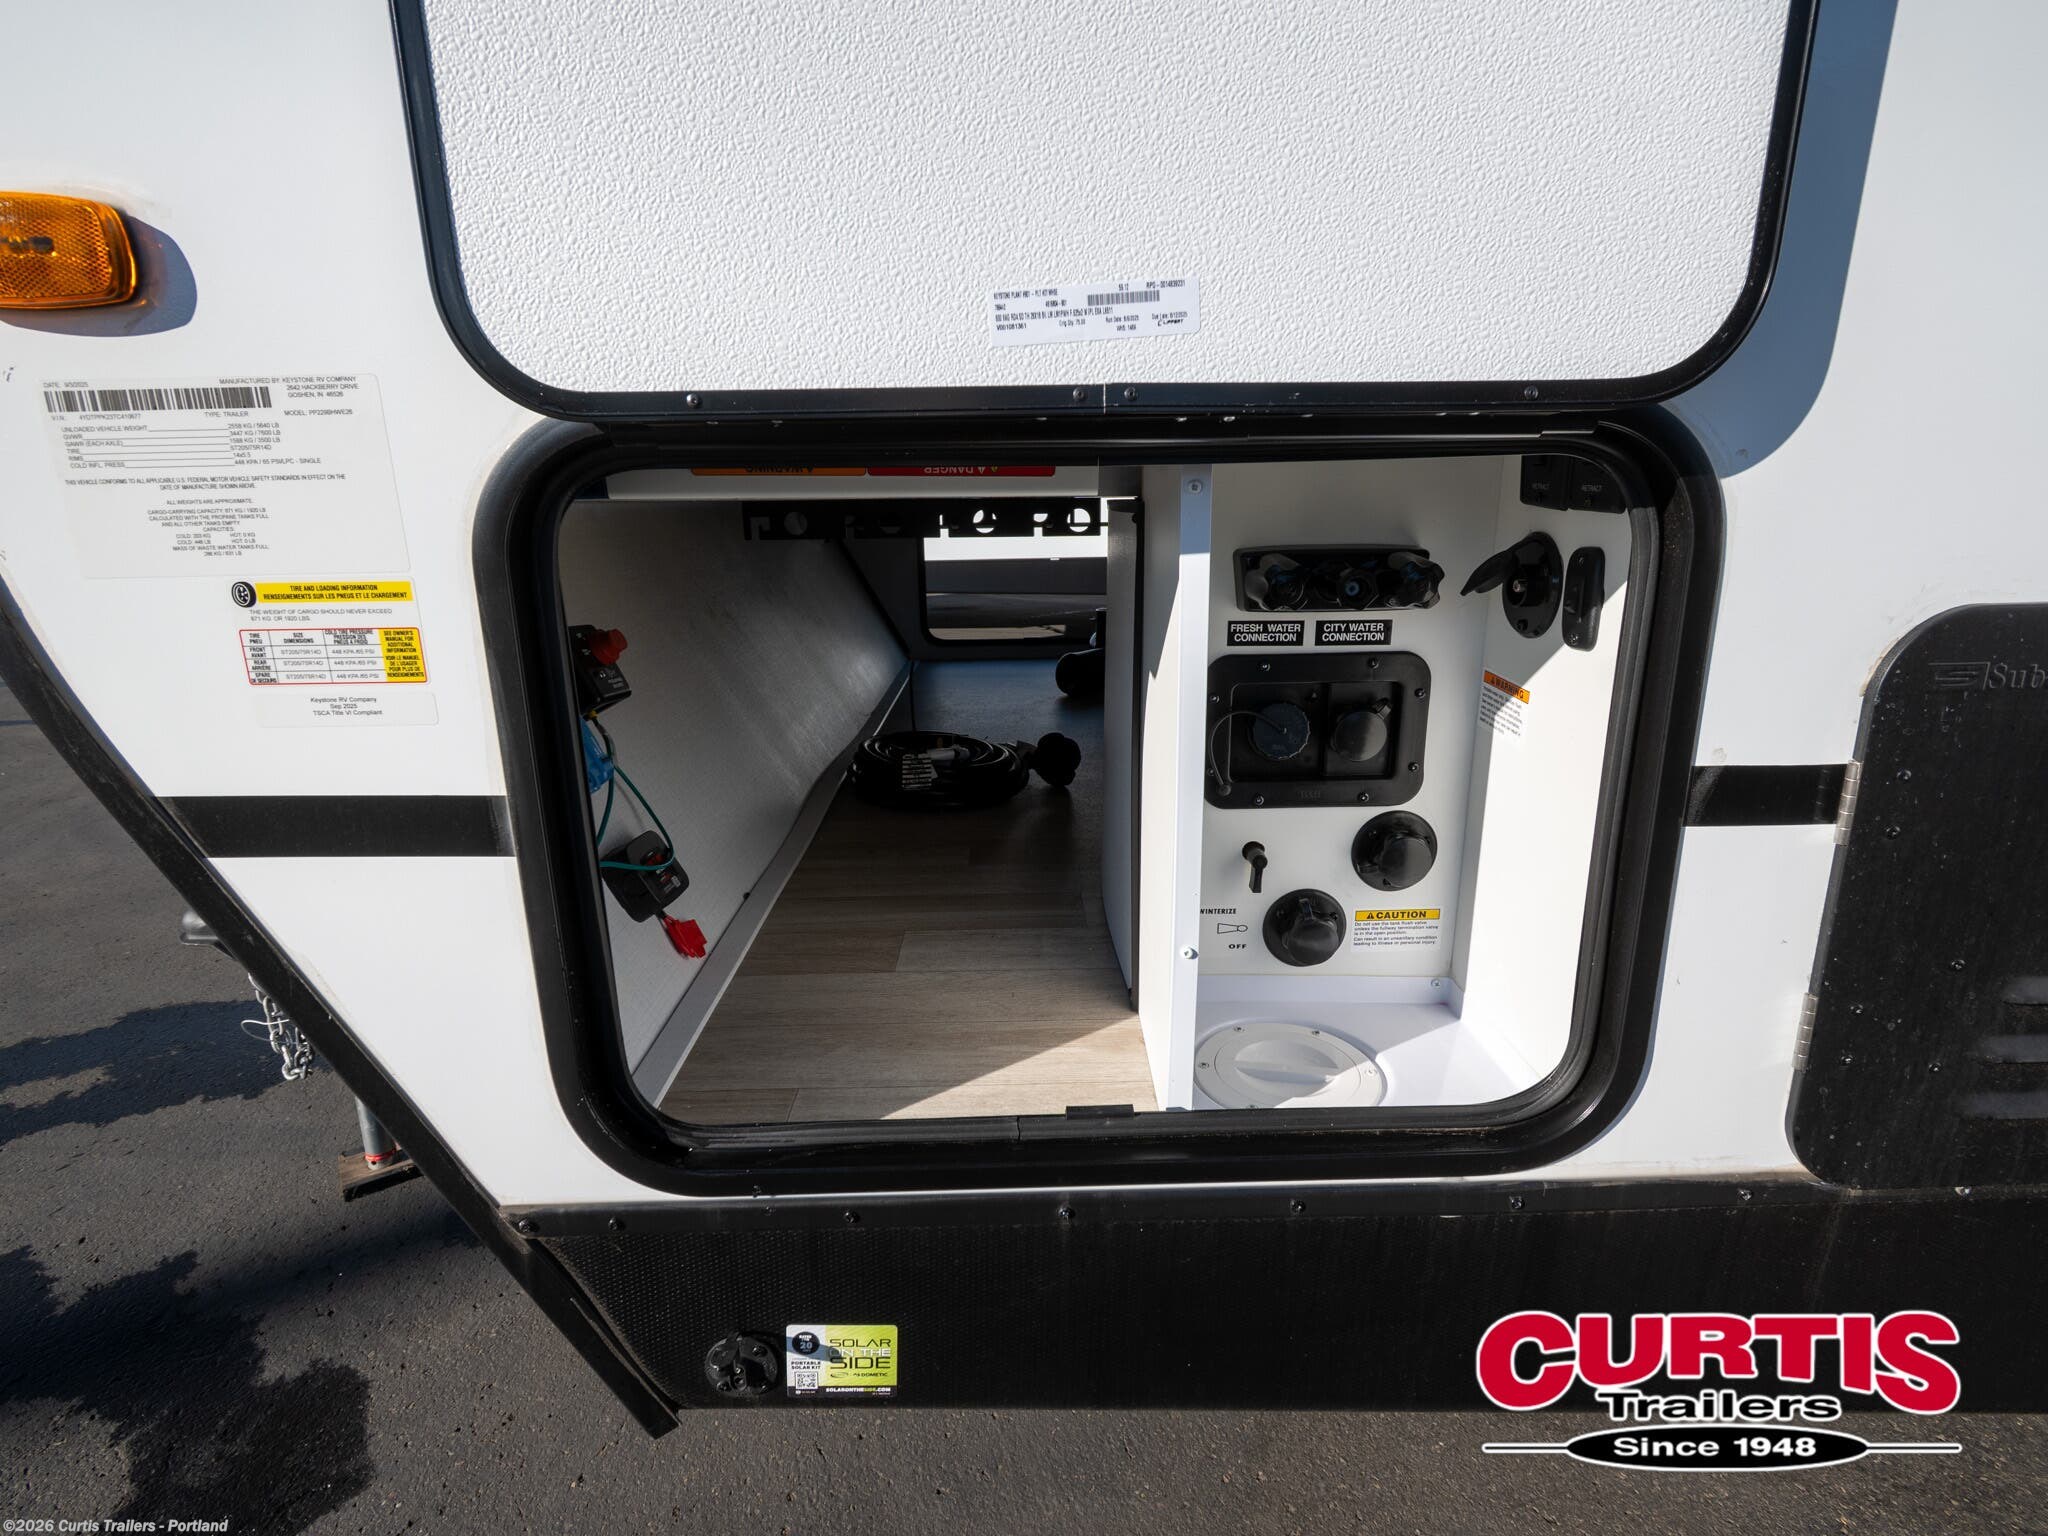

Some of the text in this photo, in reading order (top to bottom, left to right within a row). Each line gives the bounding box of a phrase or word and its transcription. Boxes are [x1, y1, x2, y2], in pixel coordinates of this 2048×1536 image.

[1230, 624, 1301, 632] FRESH WATER
[1323, 622, 1384, 632] CITY WATER
[1234, 633, 1297, 642] CONNECTION
[1322, 632, 1384, 641] CONNECTION
[1495, 677, 1524, 699] WARNING
[830, 1339, 891, 1347] SOLAR
[830, 1348, 891, 1357] ON THE
[830, 1357, 890, 1369] SIDE
